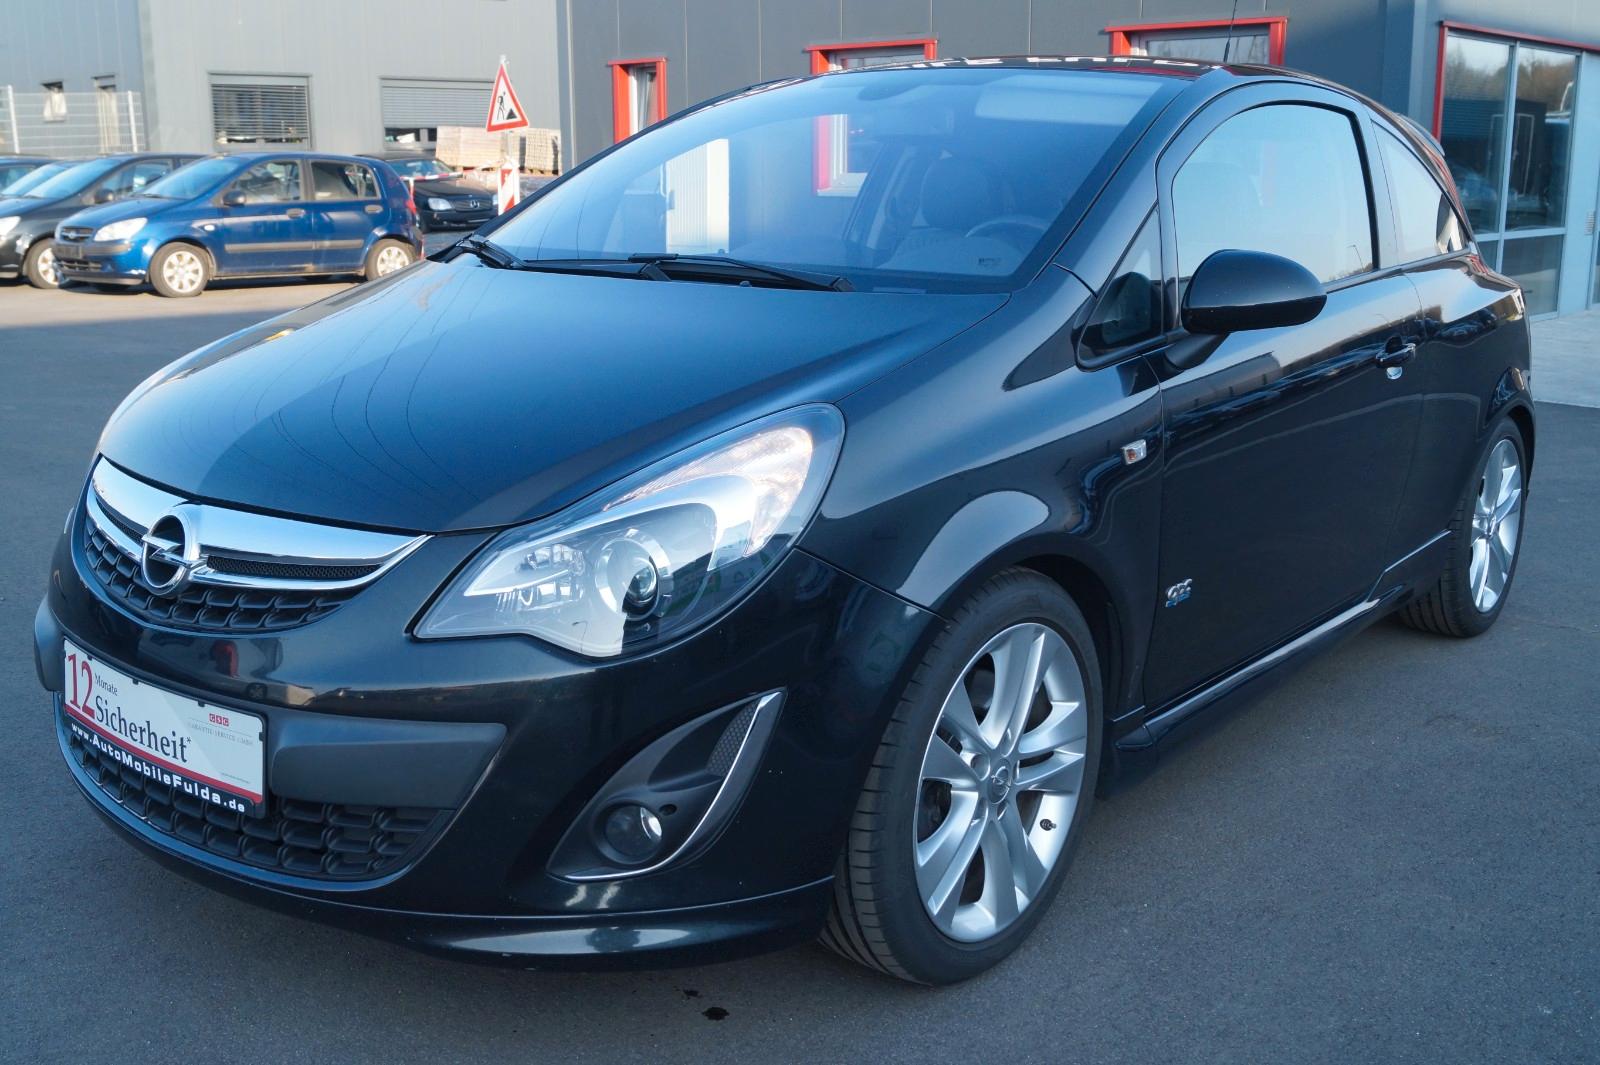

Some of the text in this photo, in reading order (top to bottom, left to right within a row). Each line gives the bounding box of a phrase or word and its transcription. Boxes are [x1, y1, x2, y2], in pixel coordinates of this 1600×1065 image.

[67, 653, 95, 720] 12
[94, 672, 118, 696] Monate
[71, 722, 246, 813] www.AutoMobileFulda.de
